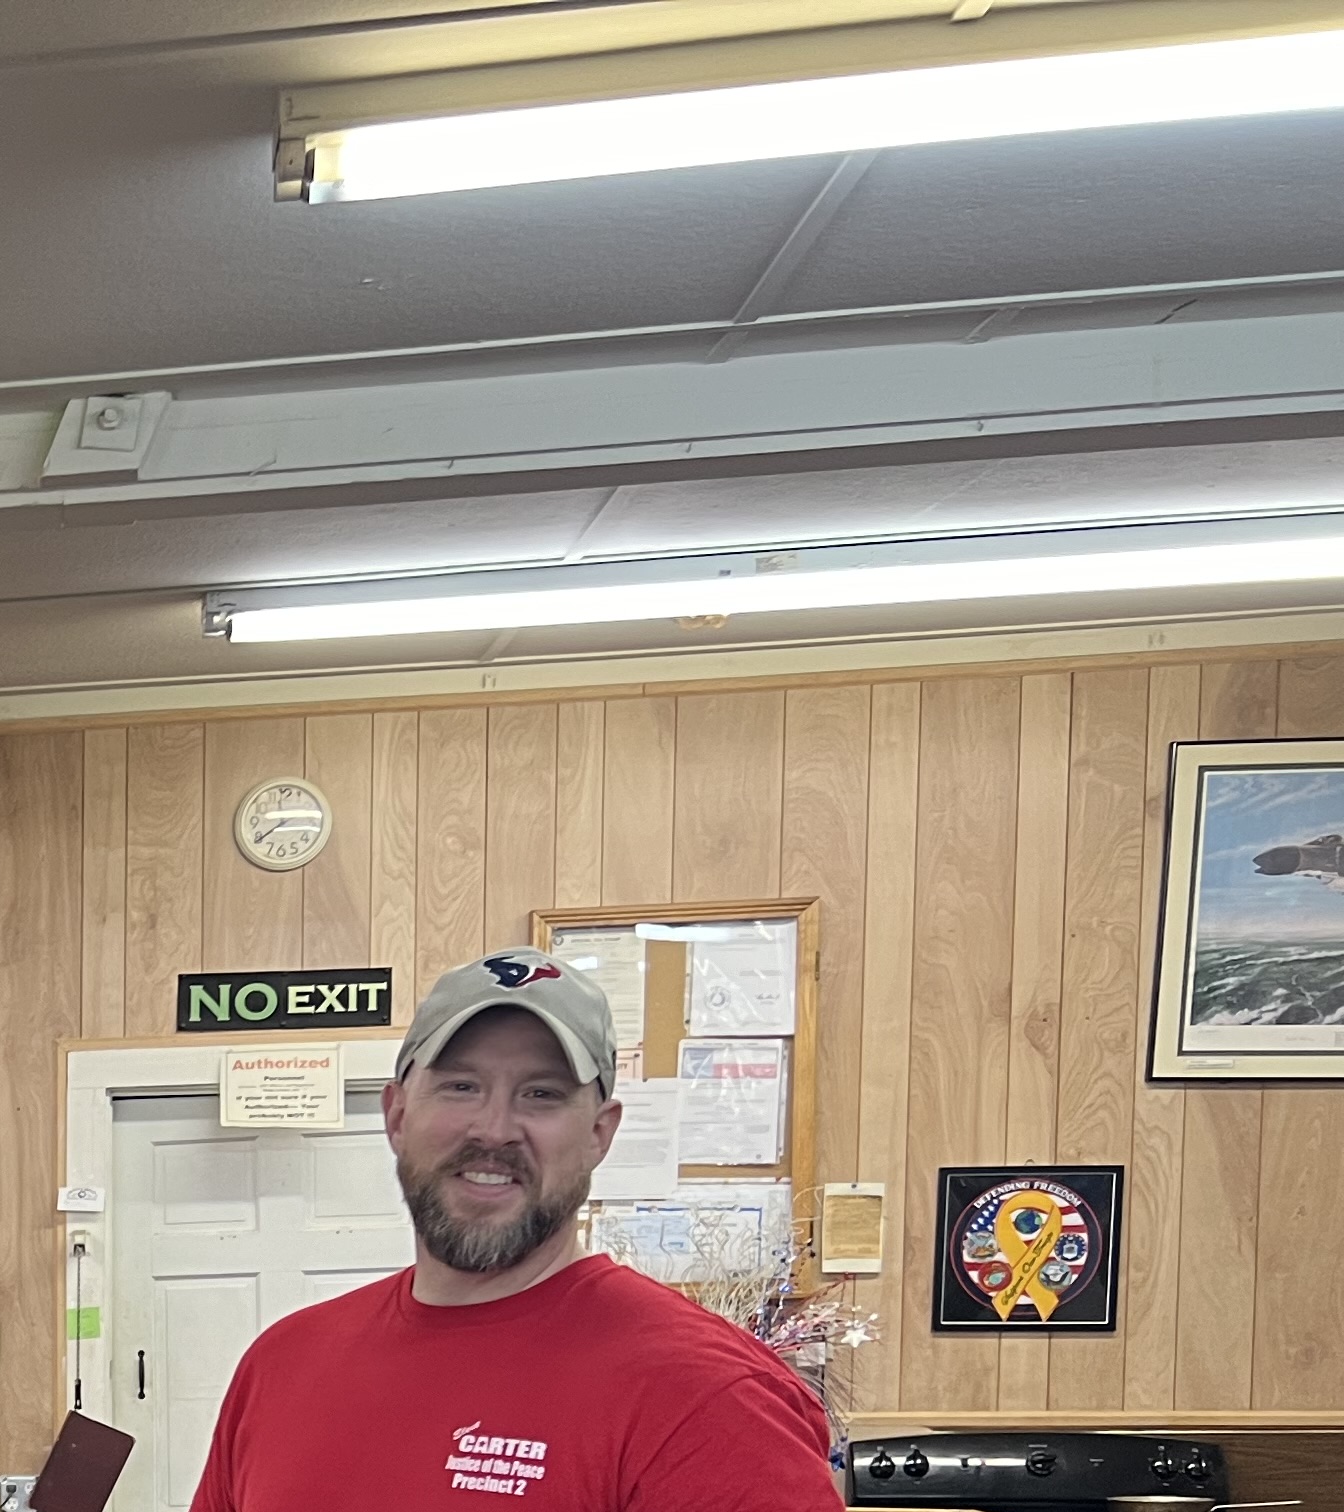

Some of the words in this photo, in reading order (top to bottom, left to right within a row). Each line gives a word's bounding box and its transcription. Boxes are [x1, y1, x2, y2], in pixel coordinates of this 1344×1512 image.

[249, 816, 259, 830] 9
[300, 832, 310, 844] 4
[265, 842, 275, 857] 7
[276, 844, 286, 858] 6
[289, 842, 299, 856] 5
[189, 982, 278, 1022] NO
[286, 982, 388, 1014] EXIT
[232, 1057, 330, 1071] Authorized
[974, 1181, 1031, 1208] DEFENDING
[1033, 1181, 1082, 1206] FREEDOM
[459, 1435, 548, 1460] CARTER
[445, 1454, 481, 1473] Justice
[481, 1458, 494, 1473] of
[493, 1460, 511, 1475] the
[510, 1461, 546, 1480] Peace
[452, 1473, 515, 1494] Precinct
[514, 1480, 527, 1496] 2
